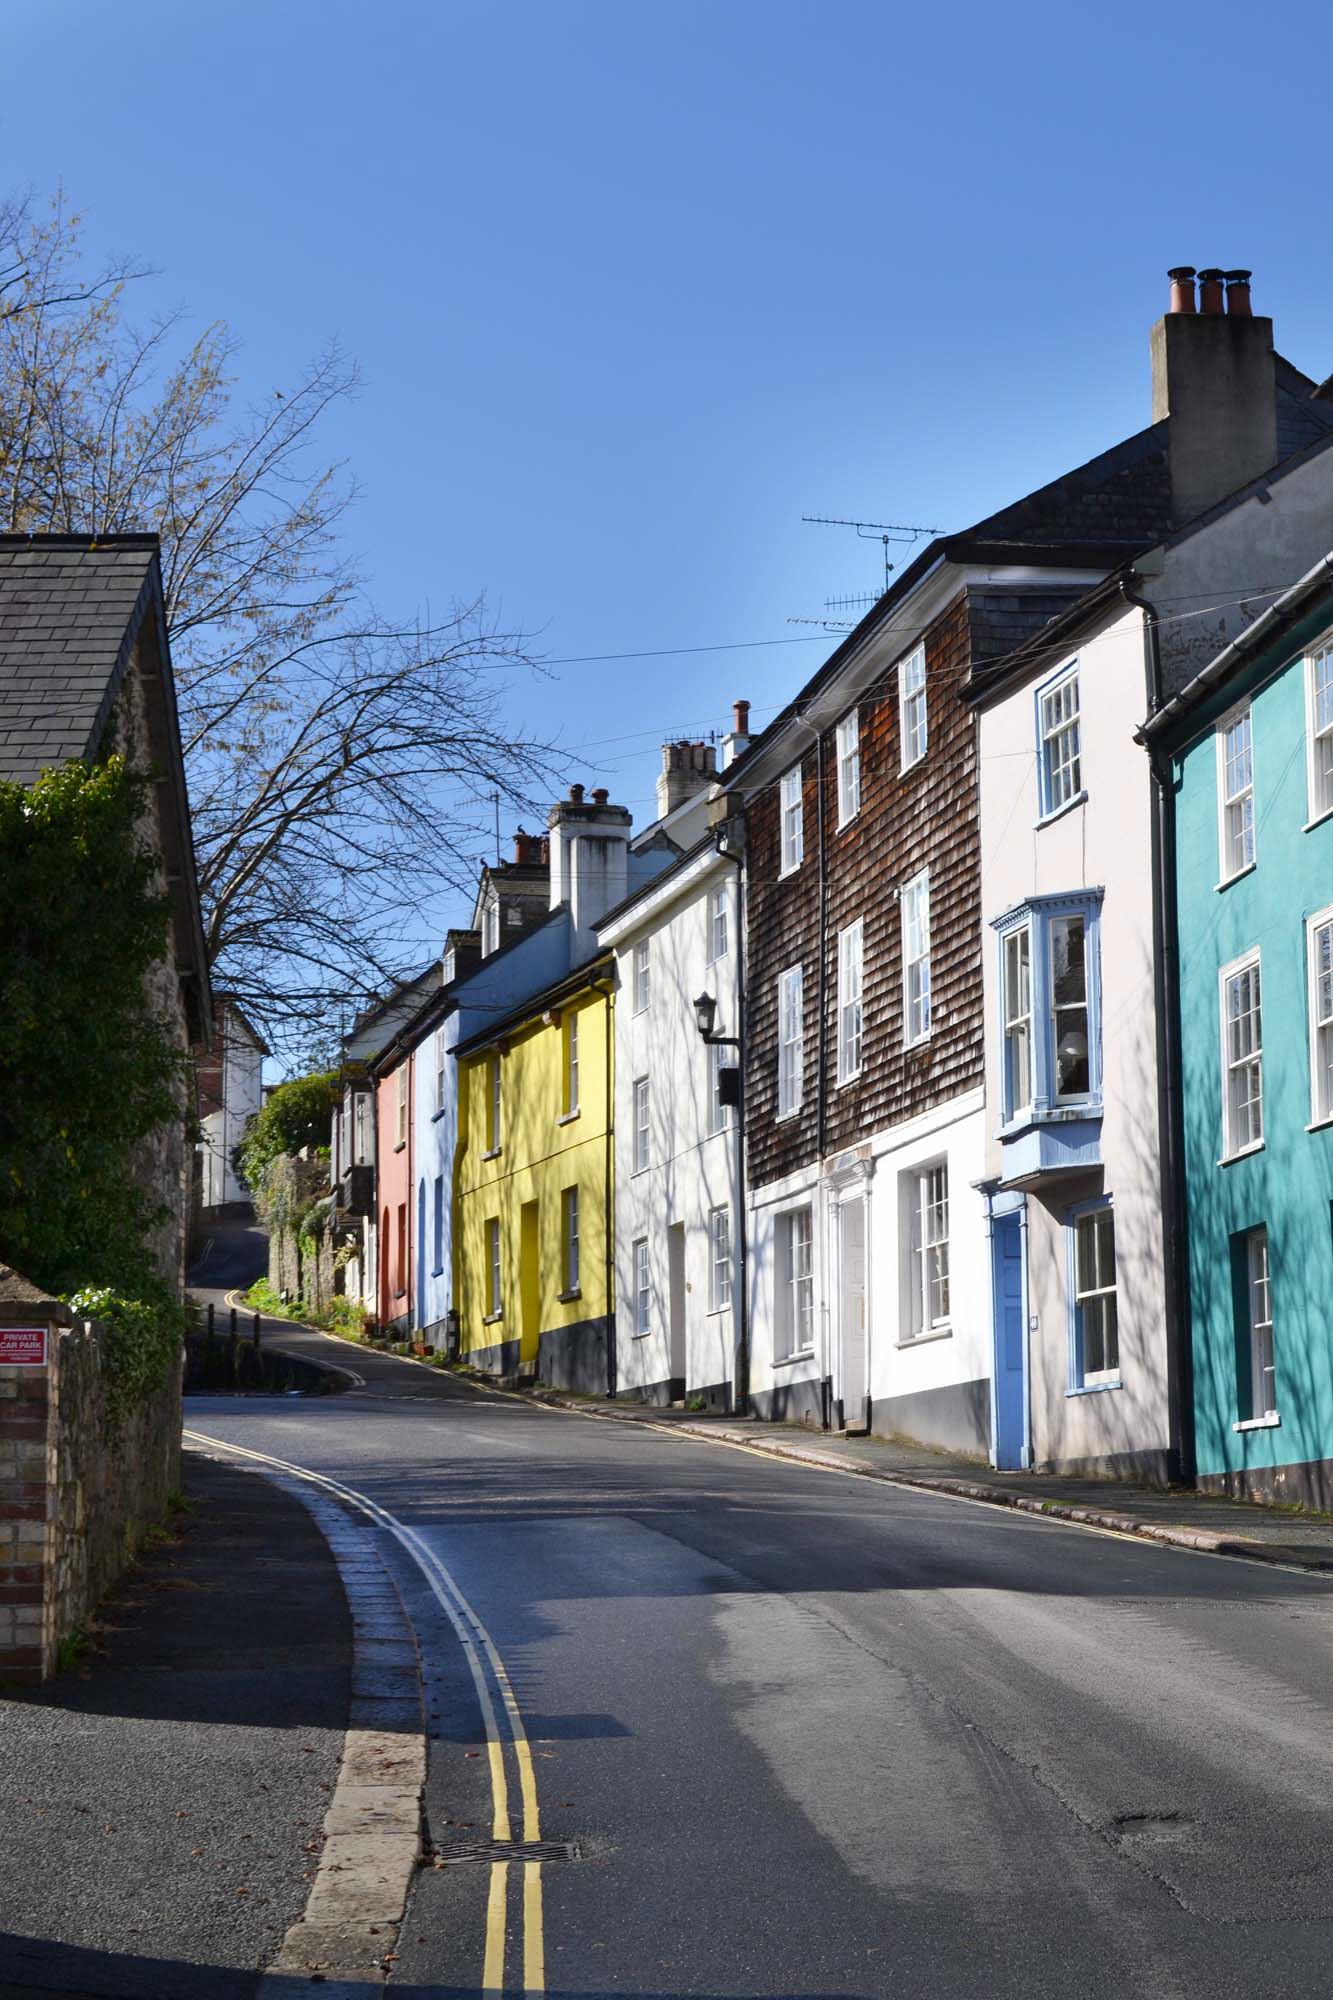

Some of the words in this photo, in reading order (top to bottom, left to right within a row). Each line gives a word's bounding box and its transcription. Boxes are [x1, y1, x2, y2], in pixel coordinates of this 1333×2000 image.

[3, 1333, 38, 1341] PRIVATE
[0, 1341, 17, 1349] CAR
[19, 1341, 41, 1349] PARK
